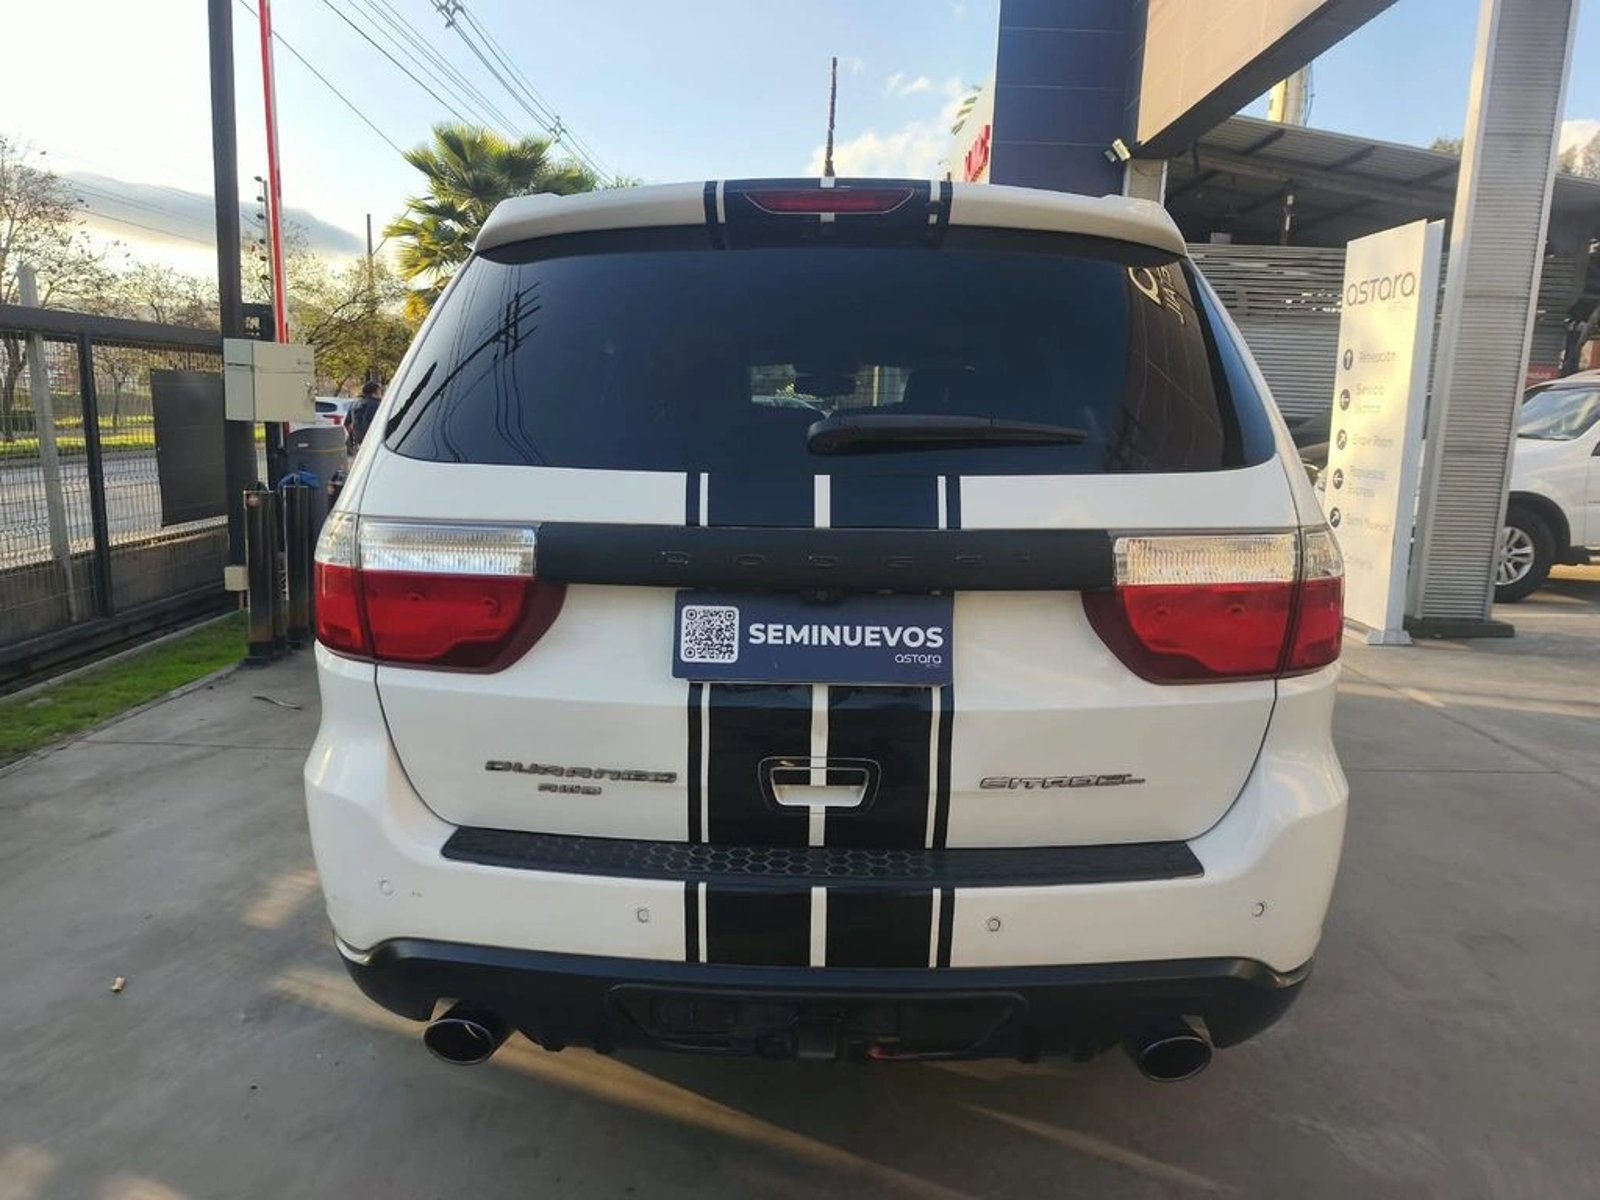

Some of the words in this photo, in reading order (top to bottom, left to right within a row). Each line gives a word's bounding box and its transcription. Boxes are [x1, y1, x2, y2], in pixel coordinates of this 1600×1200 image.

[748, 622, 945, 649] SEMINUEVOS
[485, 759, 678, 784] DURANGO
[979, 773, 1147, 790] CITADEL
